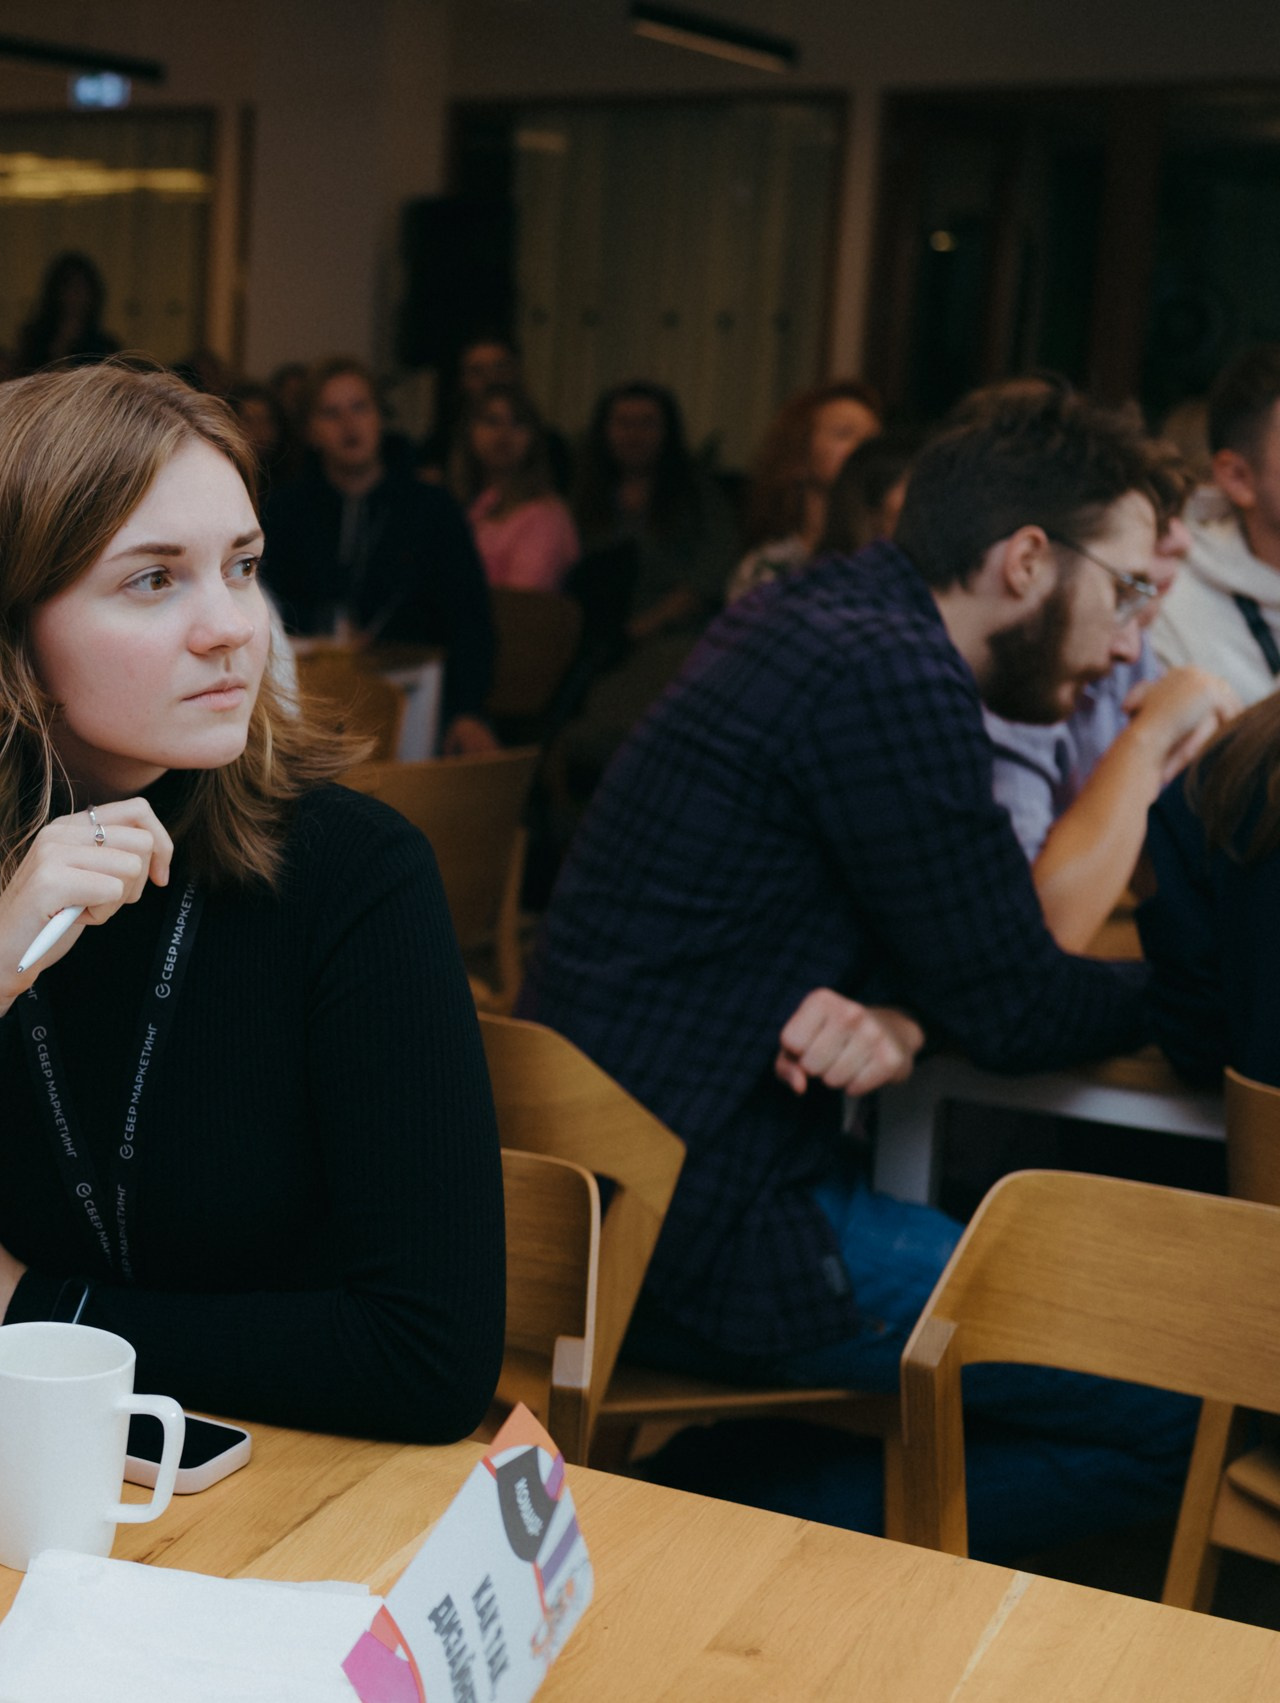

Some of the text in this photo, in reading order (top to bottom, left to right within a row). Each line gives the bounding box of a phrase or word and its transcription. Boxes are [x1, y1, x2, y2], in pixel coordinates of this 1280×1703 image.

[162, 875, 199, 981] СБЕР МАРКЕТИ
[37, 1043, 78, 1159] СБЕР МАРКЕТИНГ
[124, 1022, 158, 1142] СБЕР МАРКЕТИНГ
[84, 1199, 103, 1230] СБЕР
[116, 1184, 129, 1257] МАРКЕТИНГ
[472, 1574, 499, 1640] КАК
